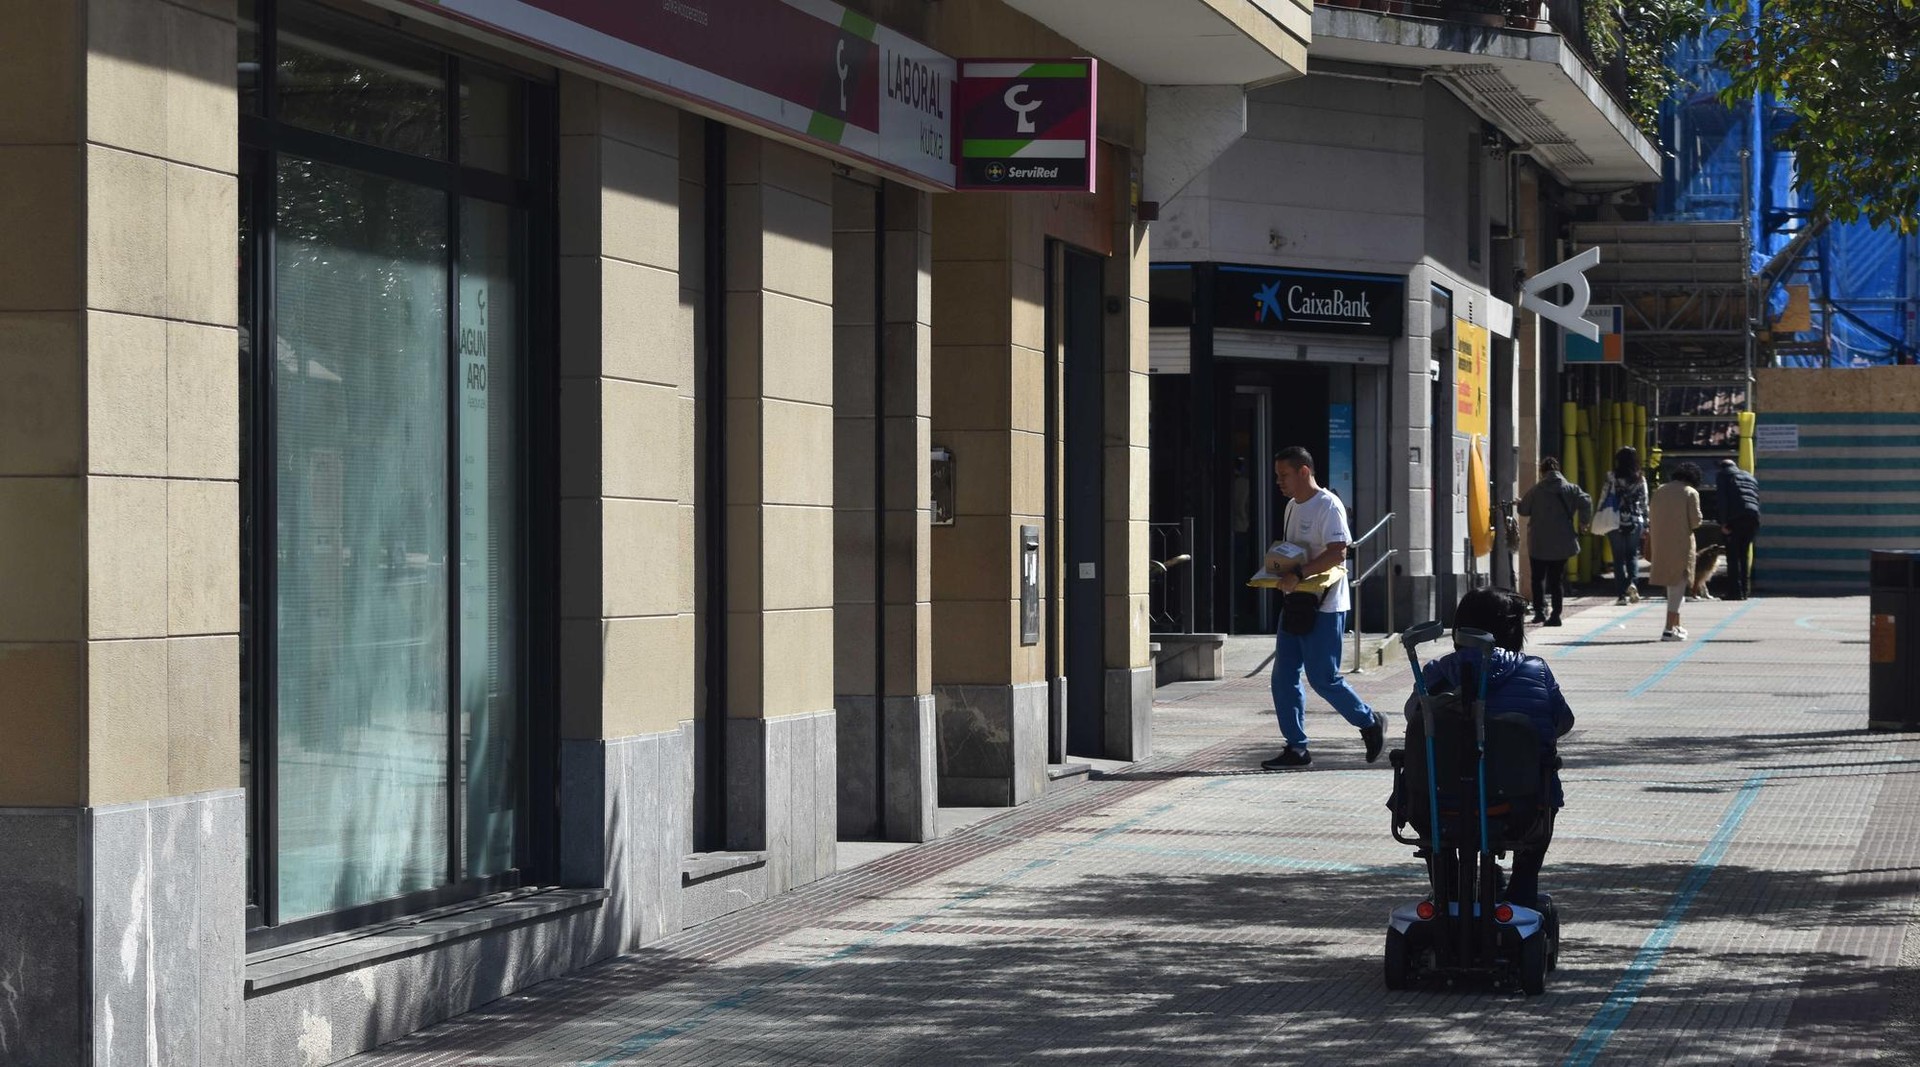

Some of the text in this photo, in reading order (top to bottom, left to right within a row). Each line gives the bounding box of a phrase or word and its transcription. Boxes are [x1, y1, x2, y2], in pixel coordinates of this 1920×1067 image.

[887, 49, 943, 120] LABORAL
[920, 120, 943, 160] kutxa
[1008, 166, 1059, 178] ServiRed
[1287, 285, 1371, 318] CaixaBank
[467, 362, 487, 391] ARO
